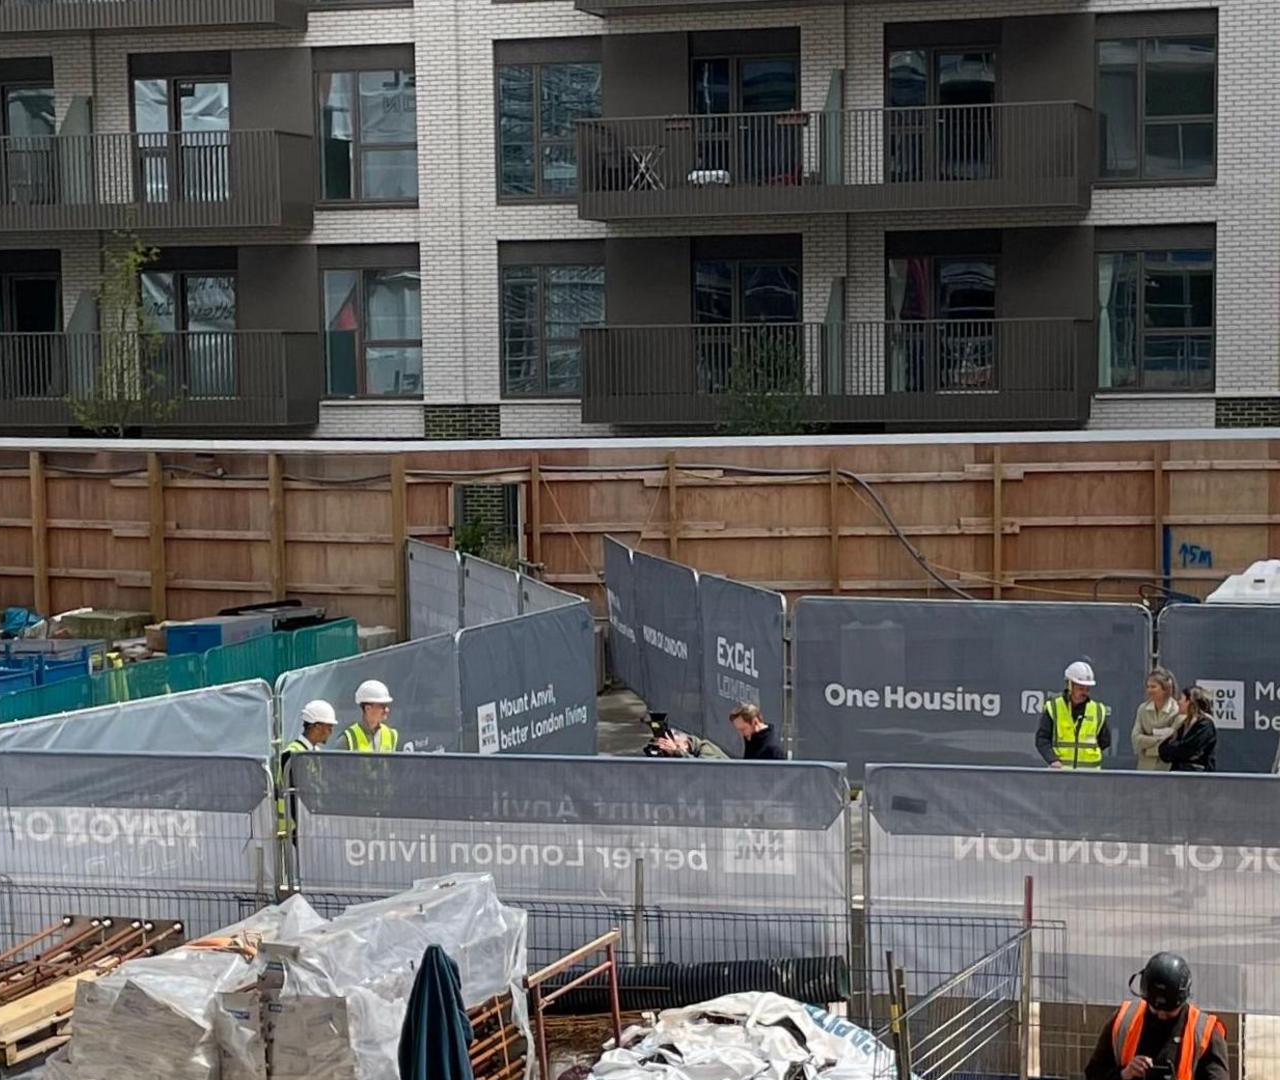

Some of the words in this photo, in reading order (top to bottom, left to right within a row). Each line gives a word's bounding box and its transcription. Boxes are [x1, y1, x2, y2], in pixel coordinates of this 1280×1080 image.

[717, 636, 759, 679] ExCeL
[499, 693, 529, 720] Mount
[530, 684, 556, 710] Anvil,
[824, 682, 880, 707] One
[883, 686, 1001, 716] Housing
[500, 728, 529, 750] better
[531, 713, 565, 739] London
[565, 704, 588, 724] living
